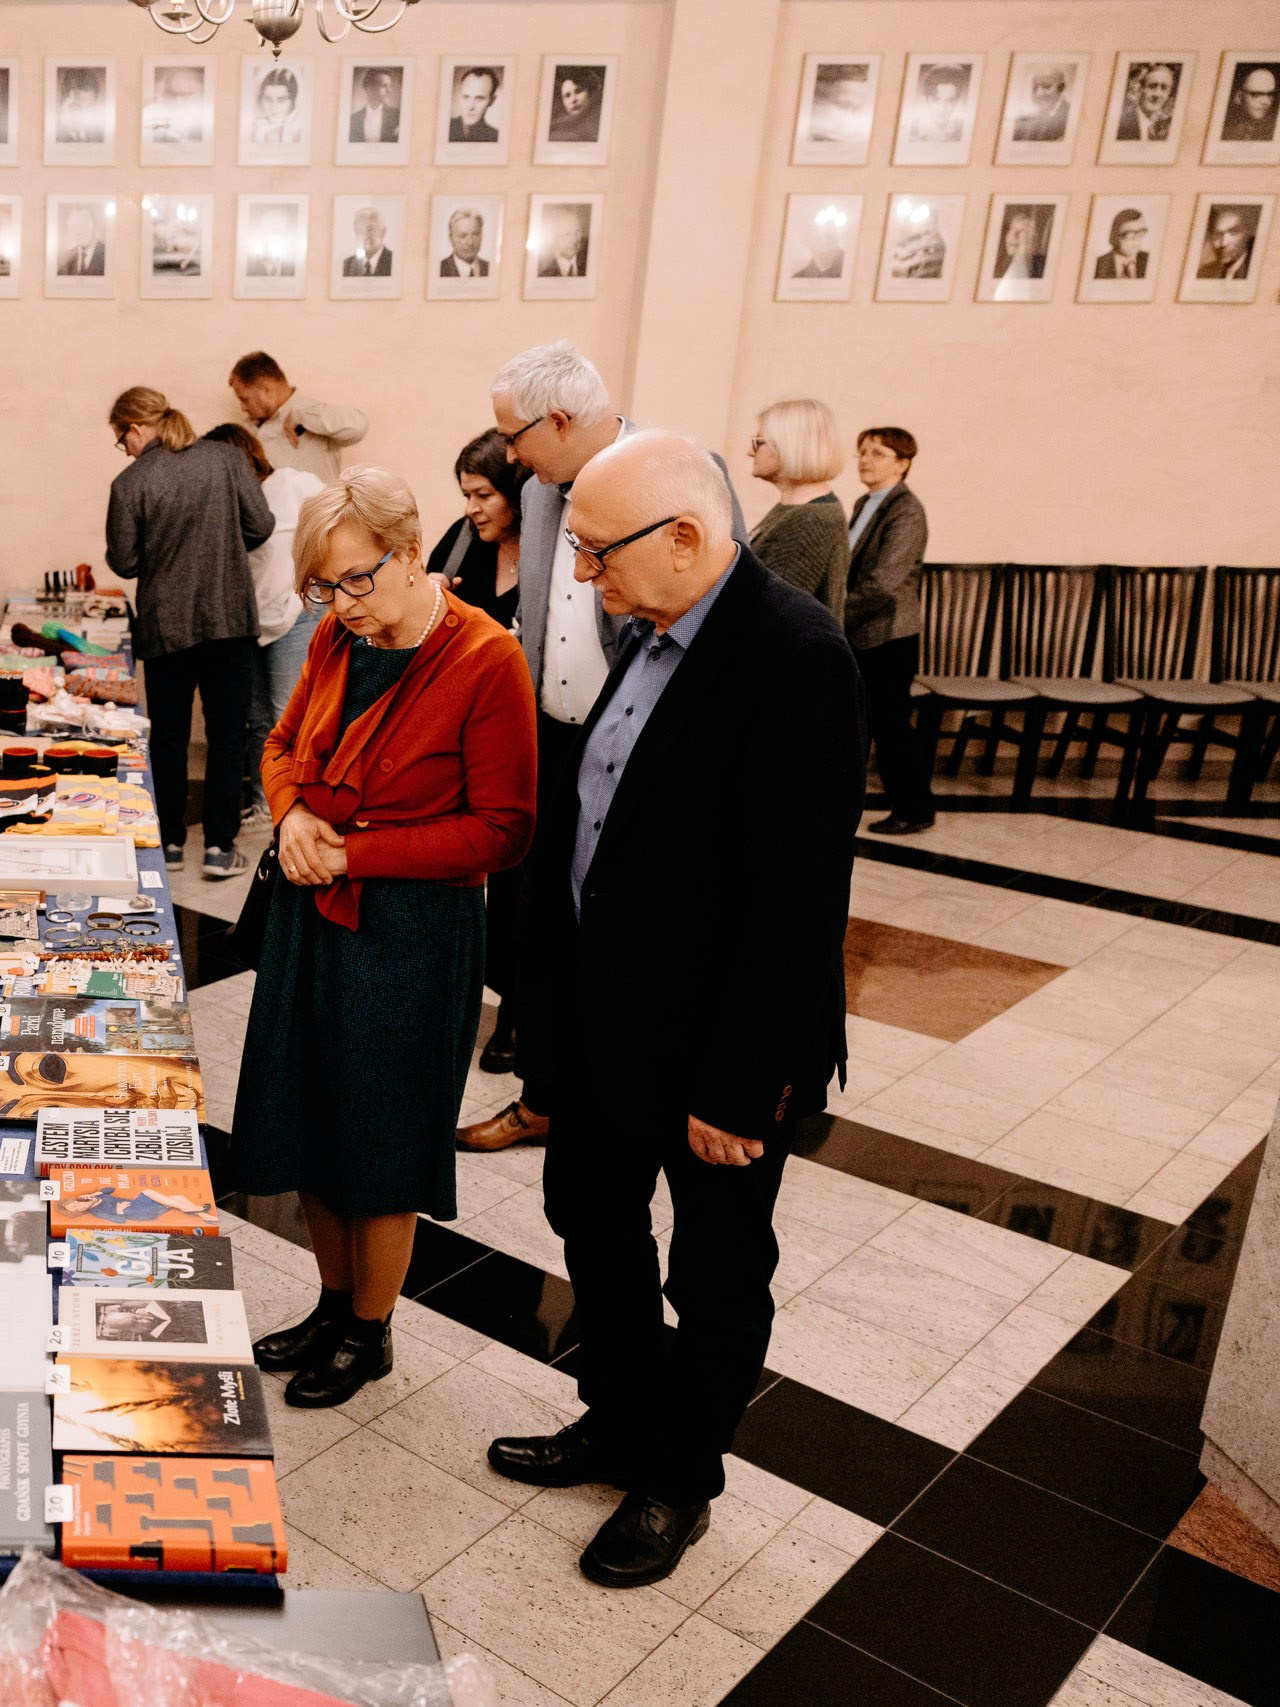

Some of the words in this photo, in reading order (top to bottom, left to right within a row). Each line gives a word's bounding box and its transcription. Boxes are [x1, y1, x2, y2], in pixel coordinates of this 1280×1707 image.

[20, 1015, 40, 1036] Parki
[46, 1008, 66, 1045] narodowe
[104, 1110, 136, 1124] SIĘ
[42, 1122, 69, 1158] JESTEM
[72, 1120, 100, 1159] MARYSIA
[104, 1126, 131, 1156] CHYBA
[135, 1129, 167, 1161] ZABIJĘ
[165, 1125, 195, 1162] DZISIAJ
[44, 1185, 54, 1196] 20
[51, 1250, 64, 1262] 10
[115, 1246, 151, 1276] GA
[156, 1248, 195, 1279] JA
[50, 1330, 62, 1346] 20
[218, 1370, 238, 1398] Myśli
[17, 1402, 30, 1438] GDYNIA
[0, 1428, 10, 1490] PHOTOGRAPHS
[17, 1441, 30, 1474] SOPOT
[14, 1478, 30, 1522] GDAŃSK
[49, 1495, 64, 1514] 20
